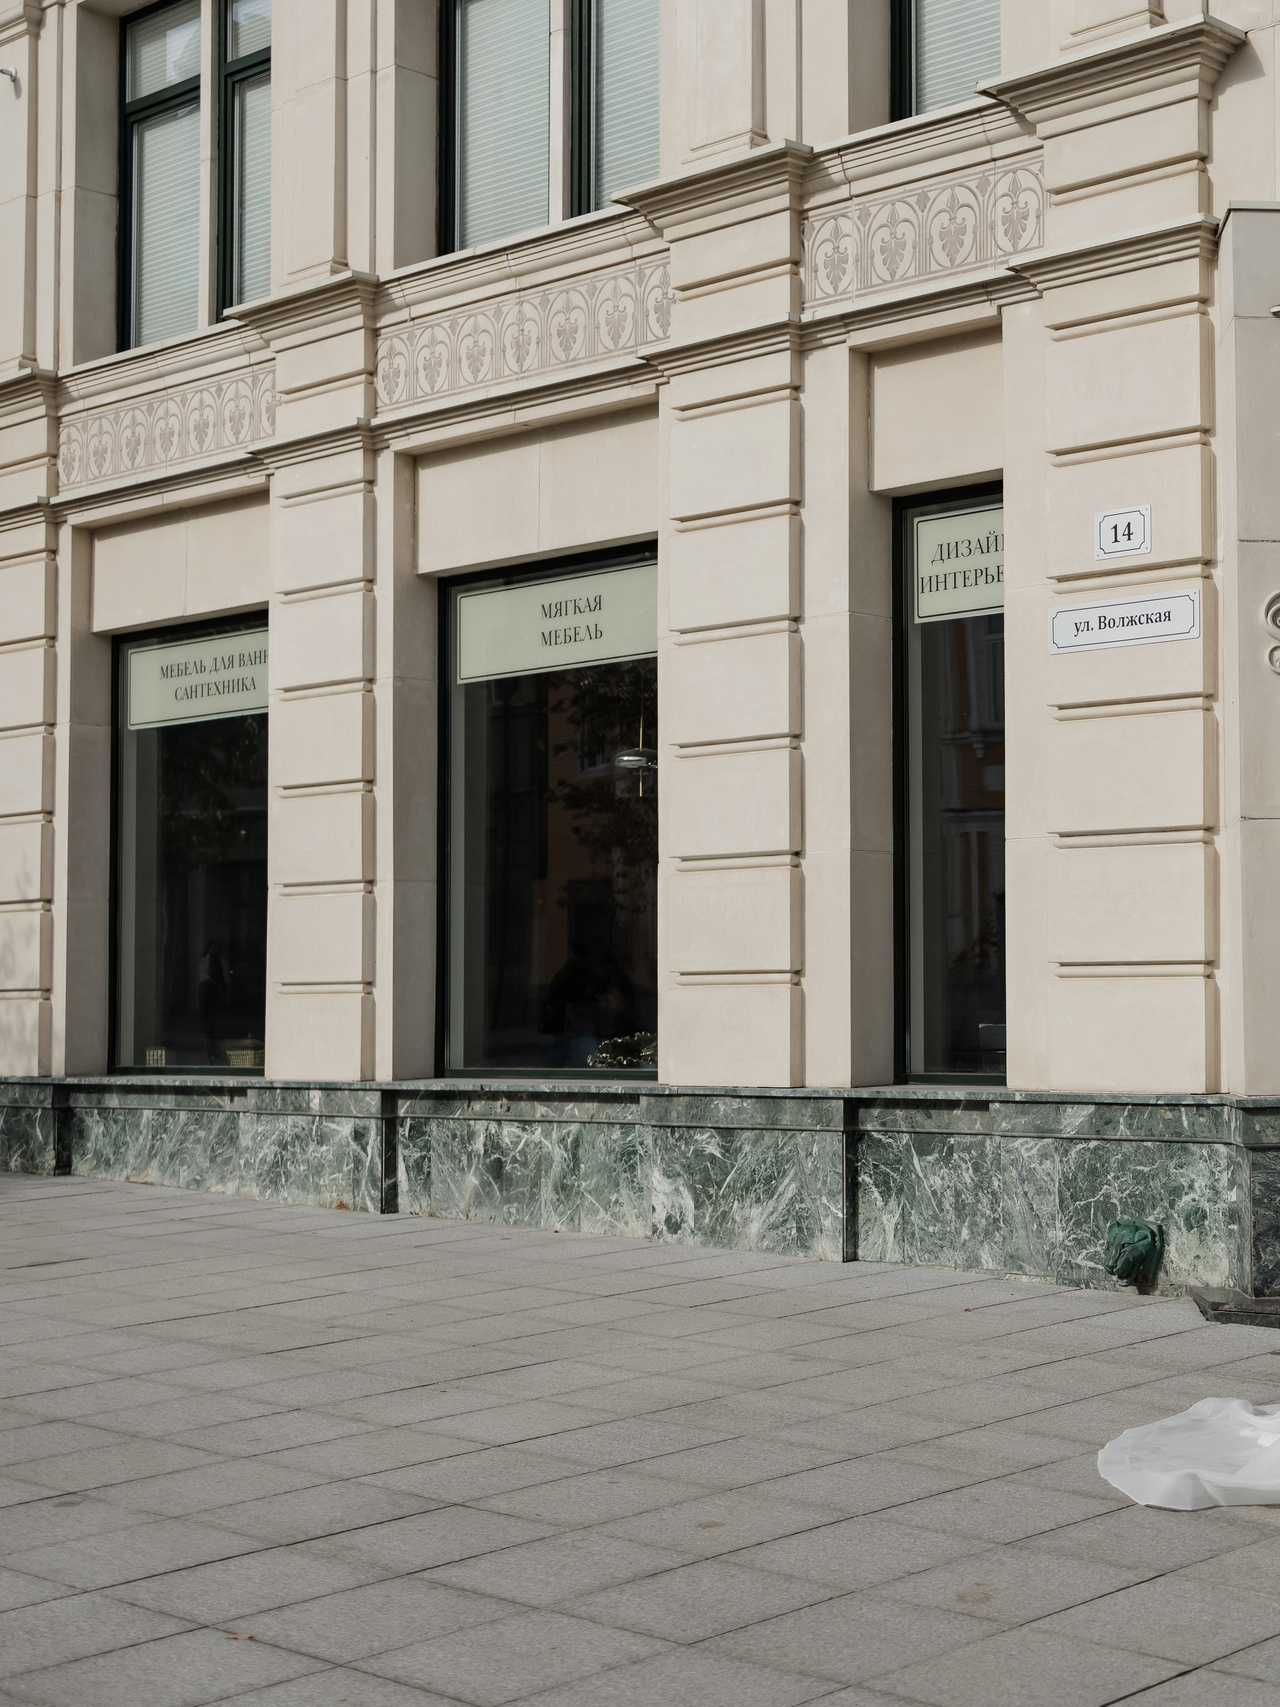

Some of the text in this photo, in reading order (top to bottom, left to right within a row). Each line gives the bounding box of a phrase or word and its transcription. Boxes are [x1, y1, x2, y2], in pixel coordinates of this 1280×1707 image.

[1110, 521, 1134, 544] 14
[931, 530, 1004, 566] ДИЗАЙ
[541, 595, 602, 619] МЯГКАЯ
[541, 623, 603, 647] МЕБЕЛЬ
[1074, 609, 1172, 638] ул. Волжская
[160, 660, 207, 680] МЕБЕЛЬ
[209, 654, 235, 675] ДЛЯ
[174, 677, 256, 701] САНТЕХНИКА
